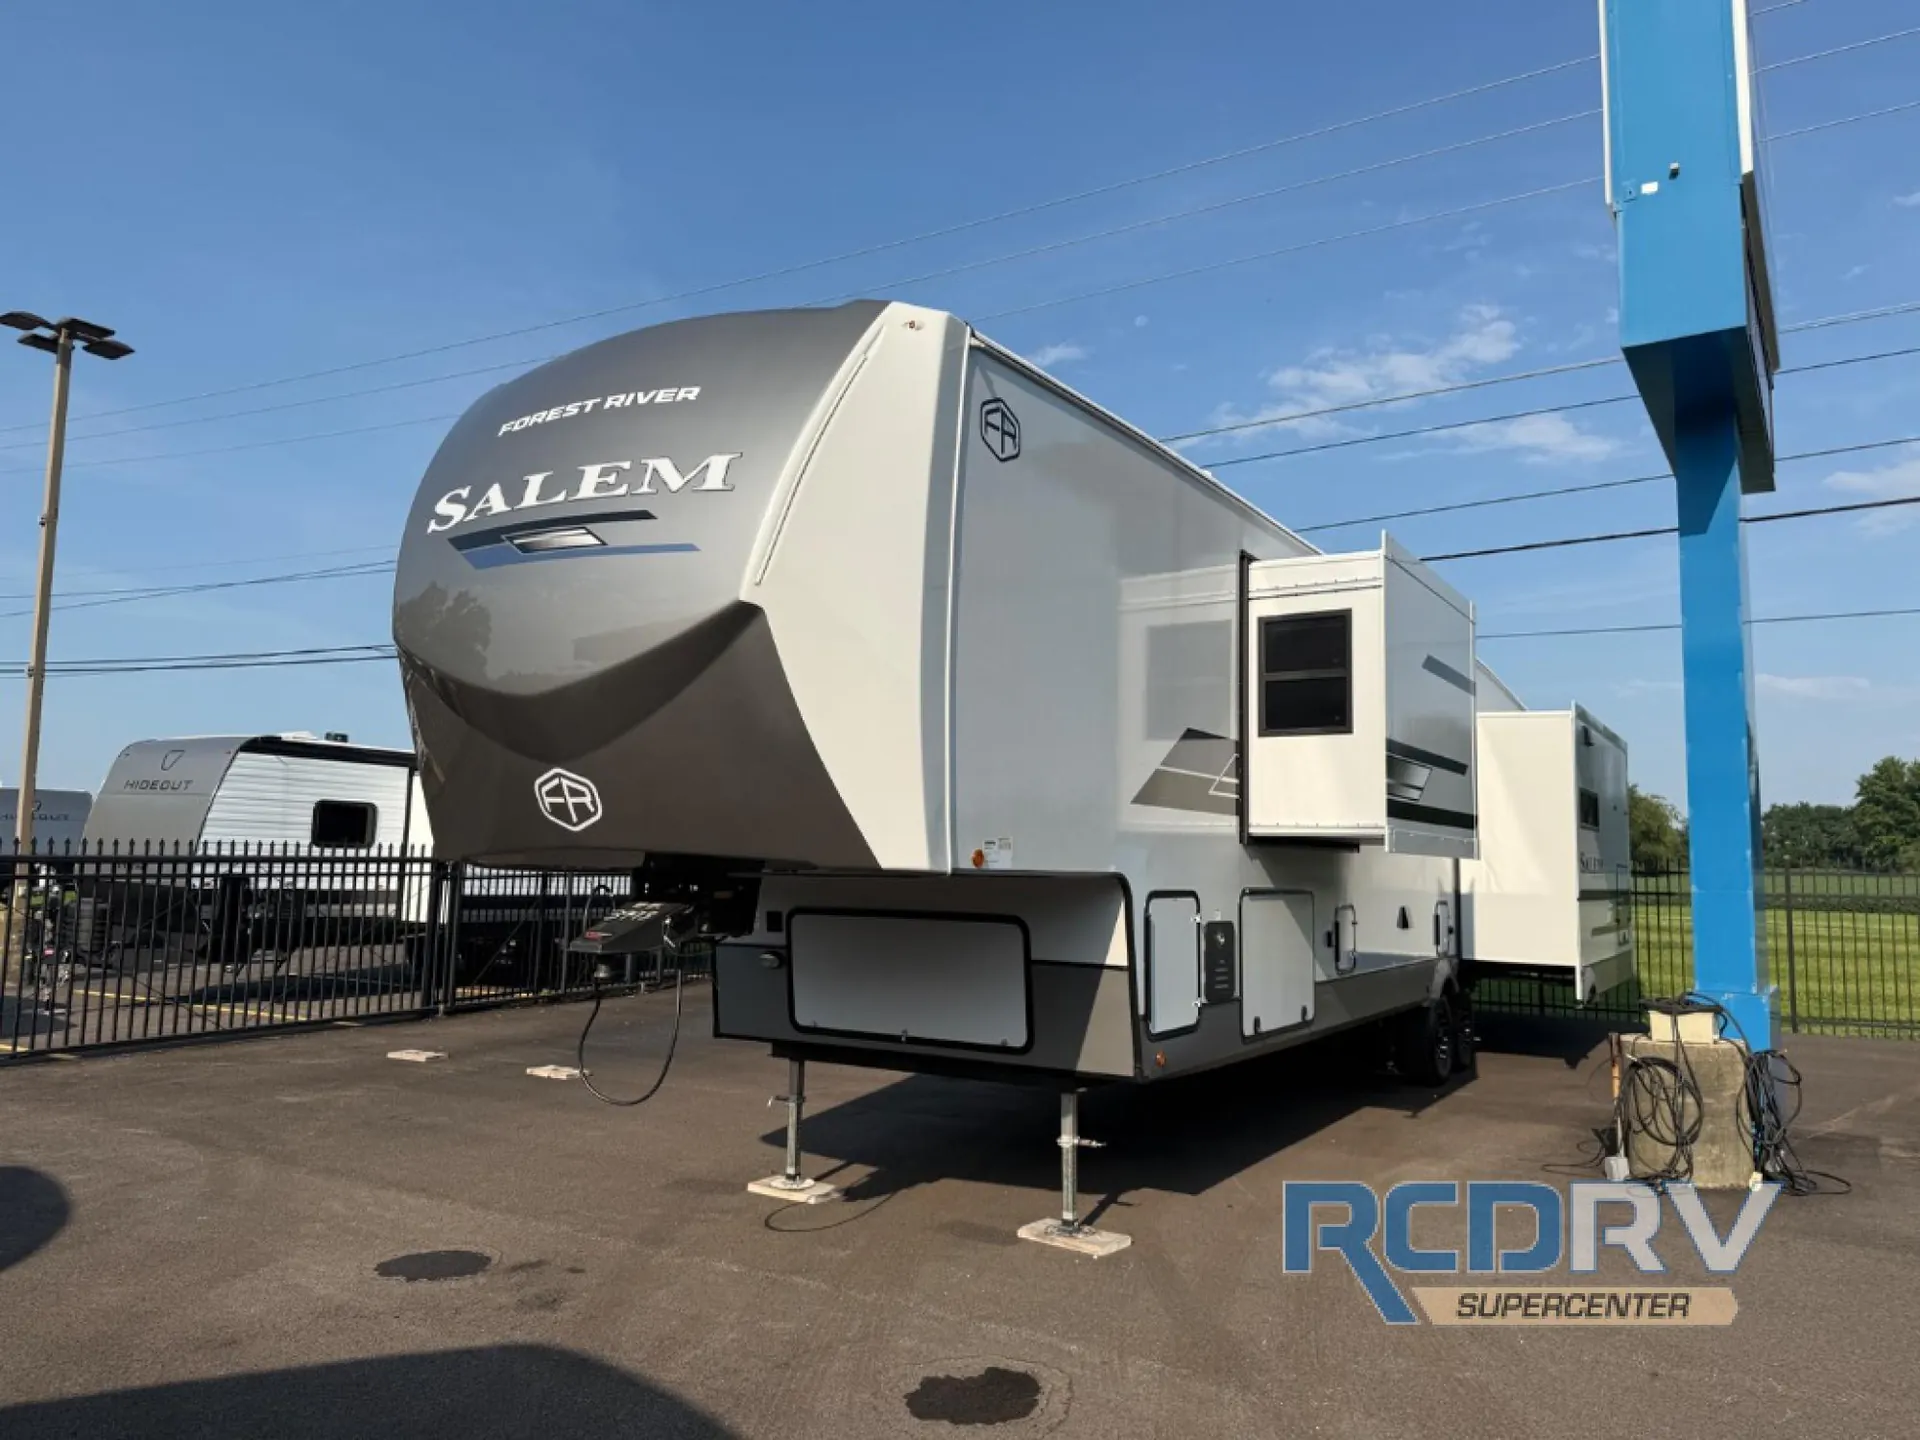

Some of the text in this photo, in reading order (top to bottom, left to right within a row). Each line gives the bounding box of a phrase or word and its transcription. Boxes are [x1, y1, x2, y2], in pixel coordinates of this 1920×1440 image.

[497, 385, 702, 437] FOREST RIVER
[426, 452, 744, 535] SALEM
[123, 779, 194, 791] HIDEOUT
